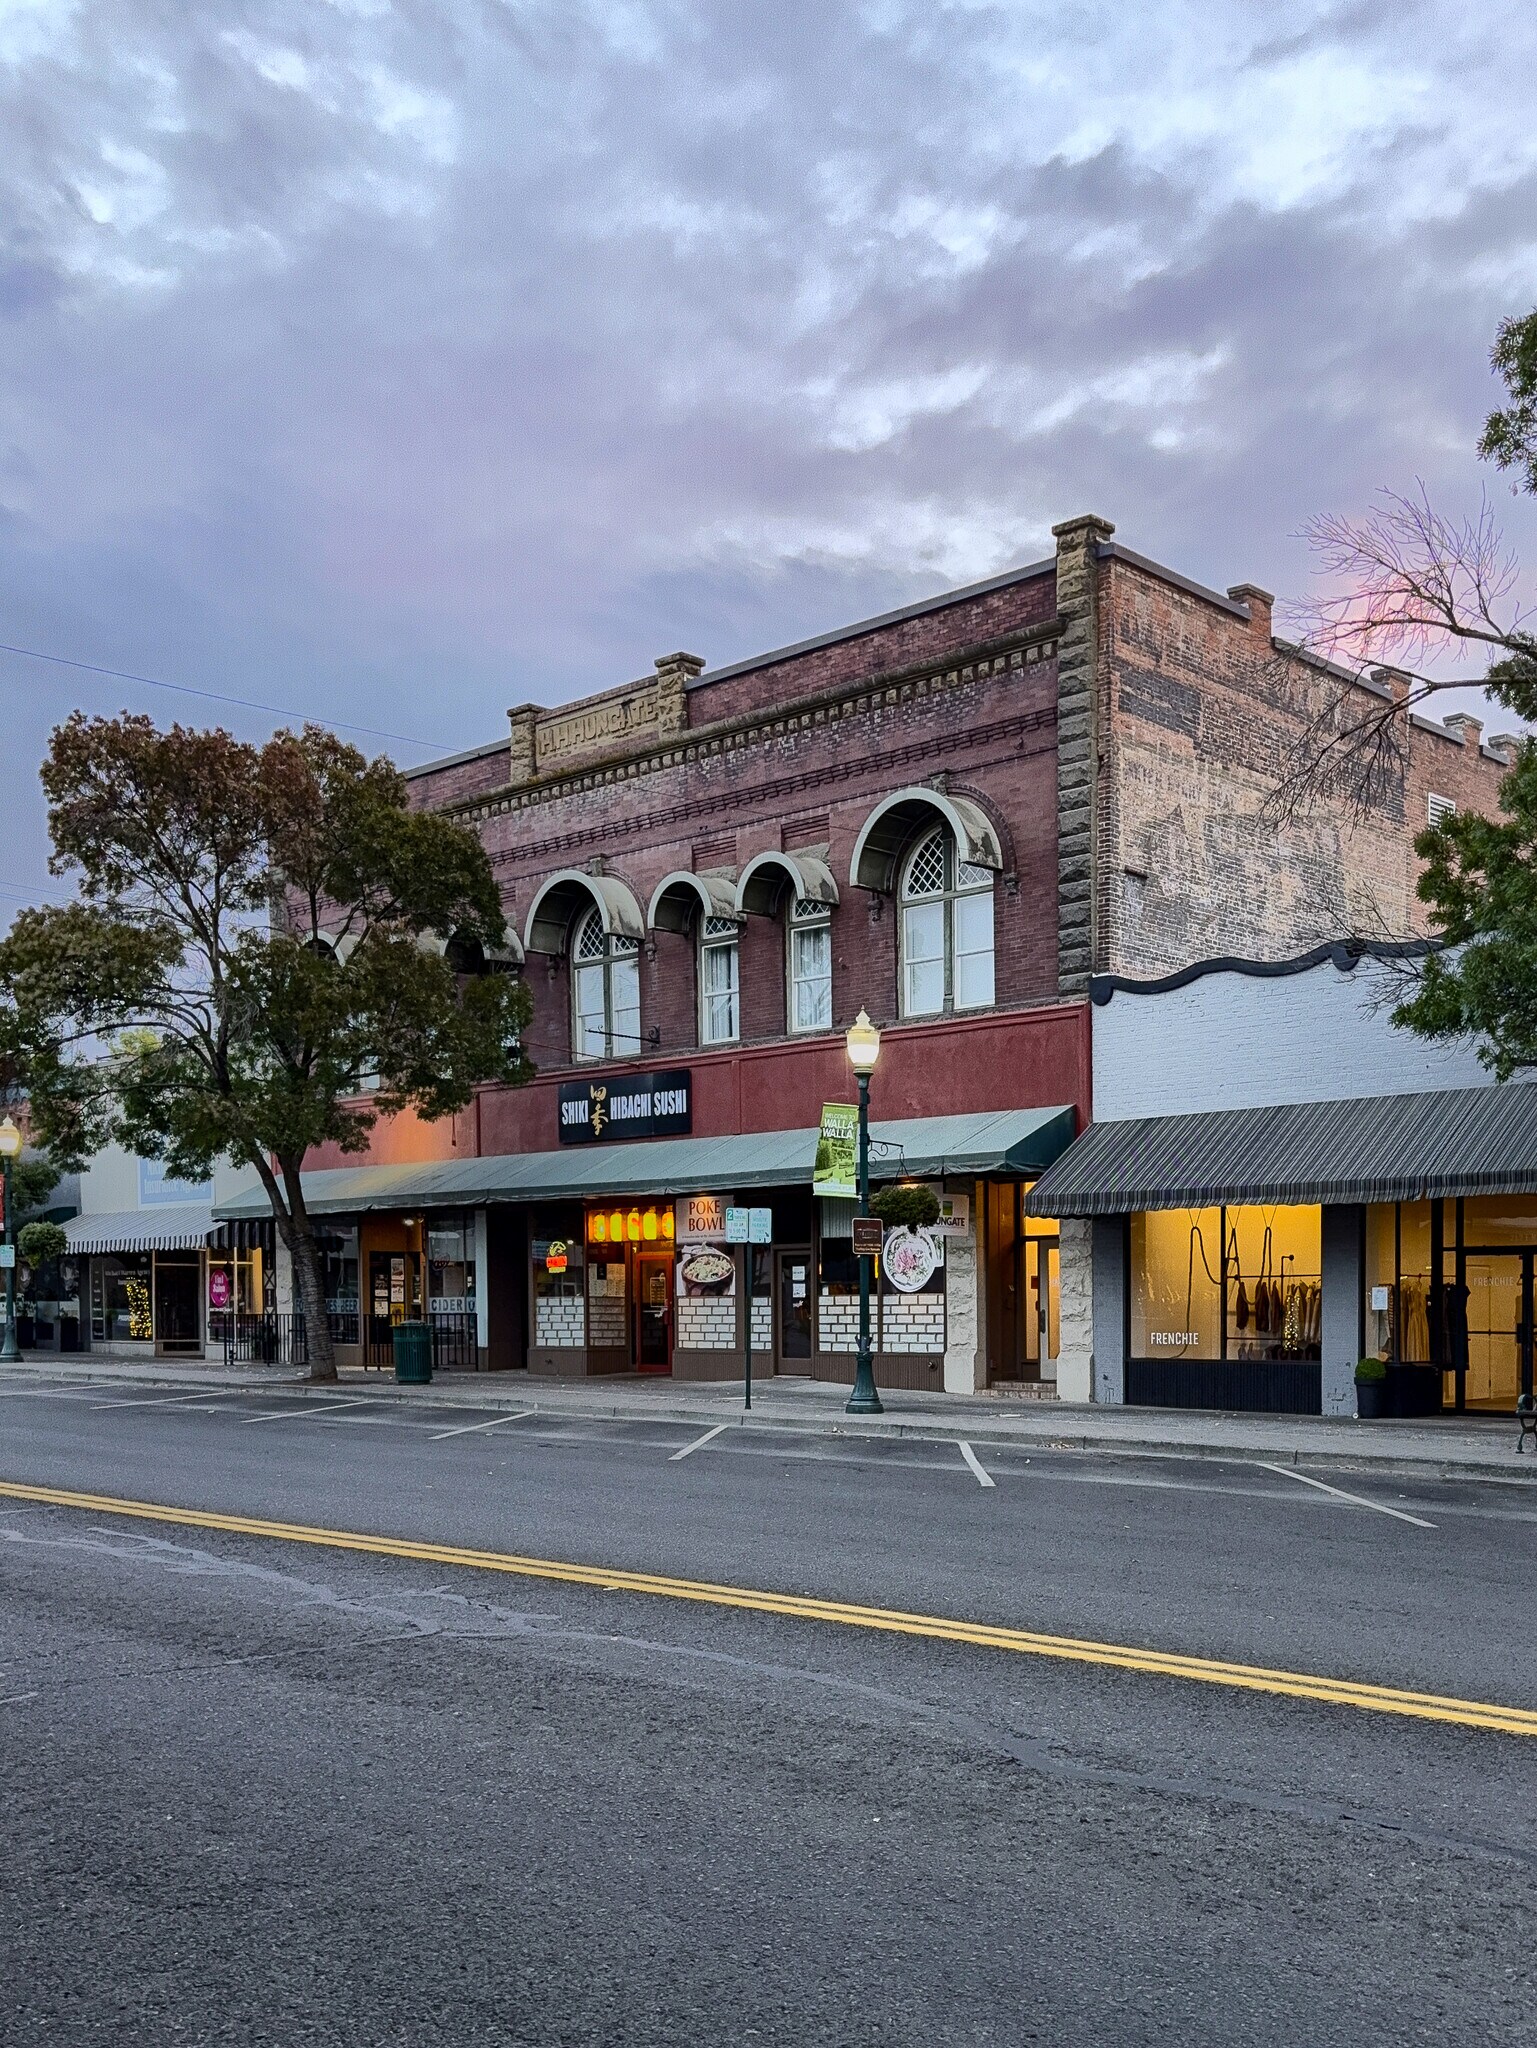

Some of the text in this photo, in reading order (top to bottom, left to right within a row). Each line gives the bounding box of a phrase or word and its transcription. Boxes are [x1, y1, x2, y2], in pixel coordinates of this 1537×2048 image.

[562, 1089, 687, 1125] SHIKI HIBACHI SUSHI
[824, 1118, 854, 1130] WALLA
[822, 1127, 854, 1139] WALLA
[689, 1200, 720, 1215] POKE
[727, 1210, 733, 1220] 2
[688, 1217, 725, 1231] BOWL
[936, 1217, 965, 1226] UNGATE
[1473, 1276, 1515, 1286] FRENCHIE
[431, 1299, 463, 1311] CIDER
[1150, 1332, 1199, 1345] FRENCHIE
